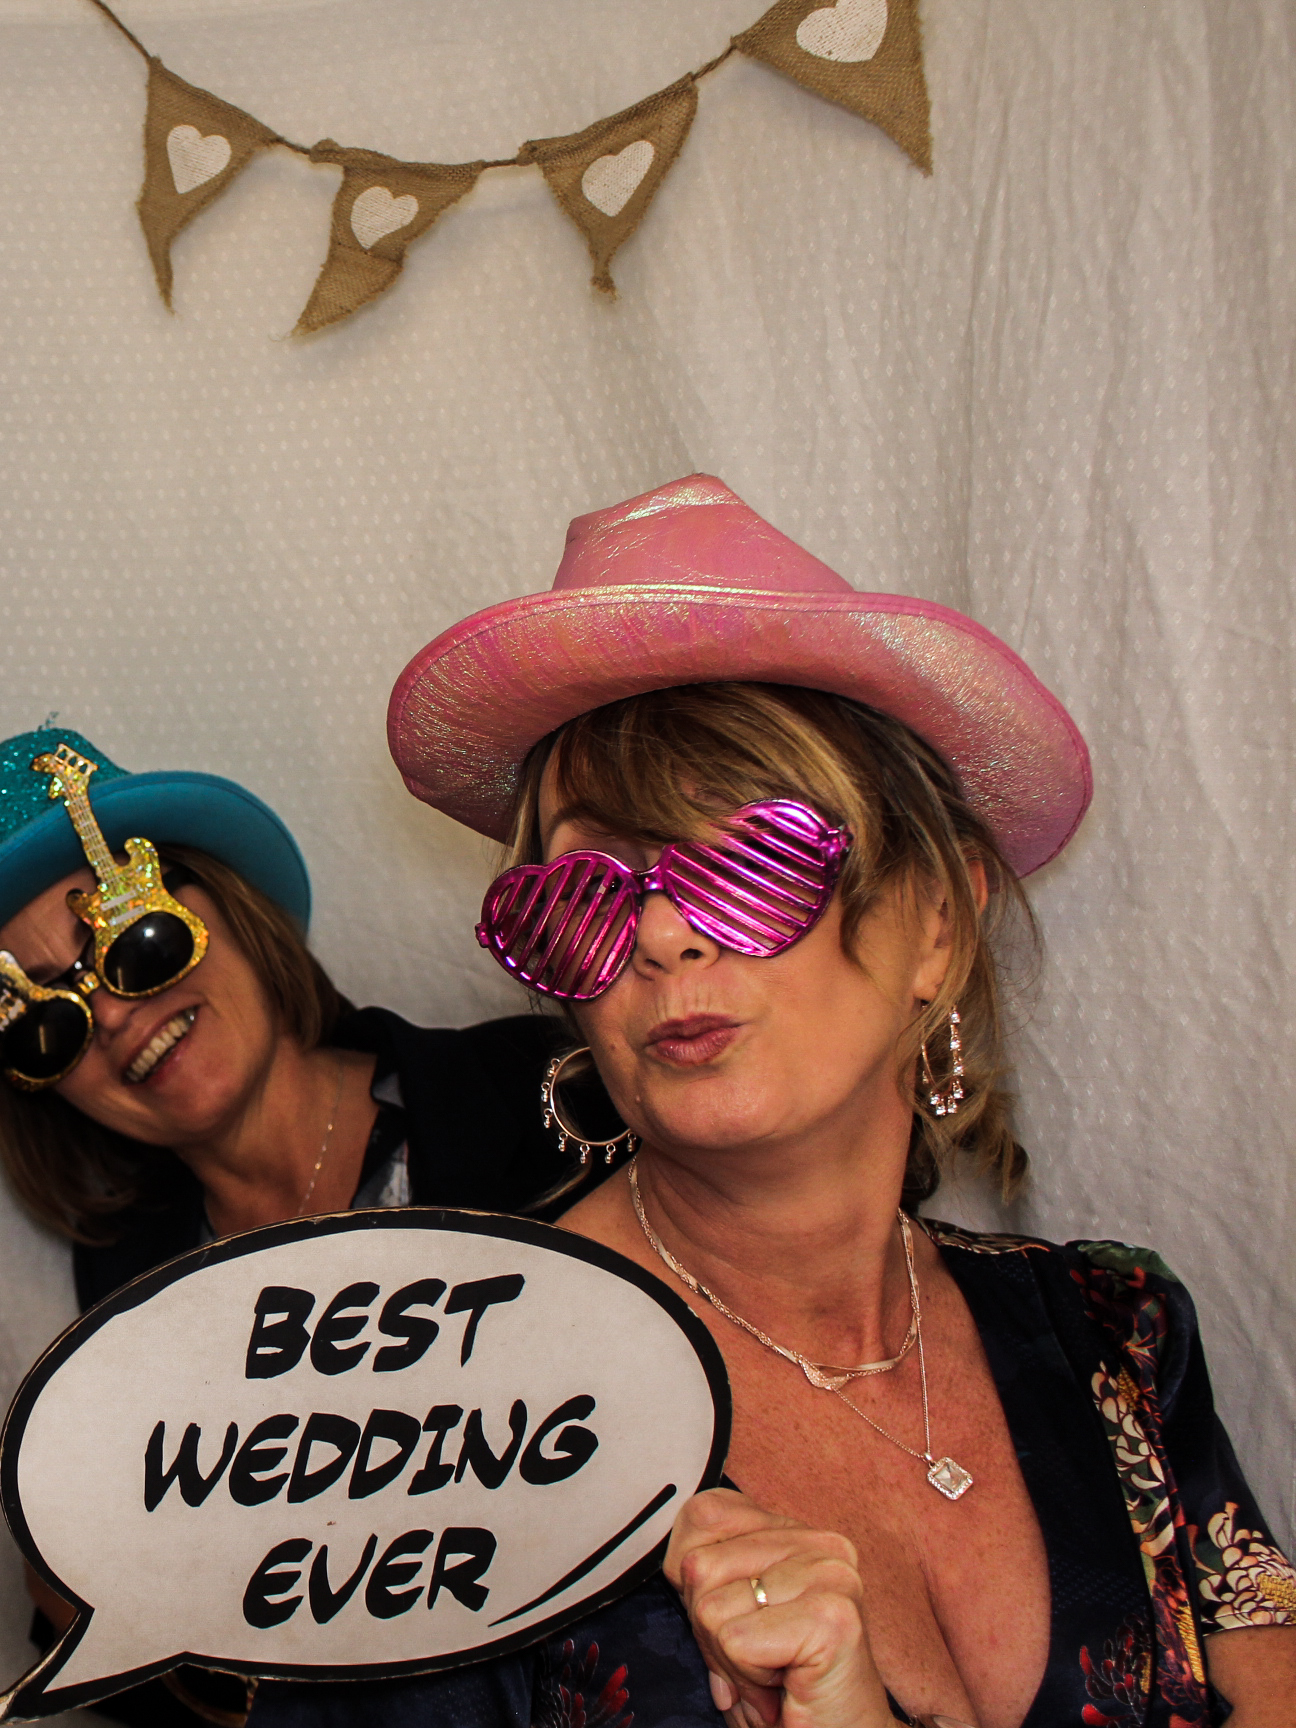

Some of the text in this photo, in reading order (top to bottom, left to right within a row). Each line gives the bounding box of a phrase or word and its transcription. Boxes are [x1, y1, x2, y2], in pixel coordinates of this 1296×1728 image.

[245, 1273, 525, 1379] BEST
[144, 1394, 600, 1512] WEDDING
[242, 1526, 498, 1629] EVER
